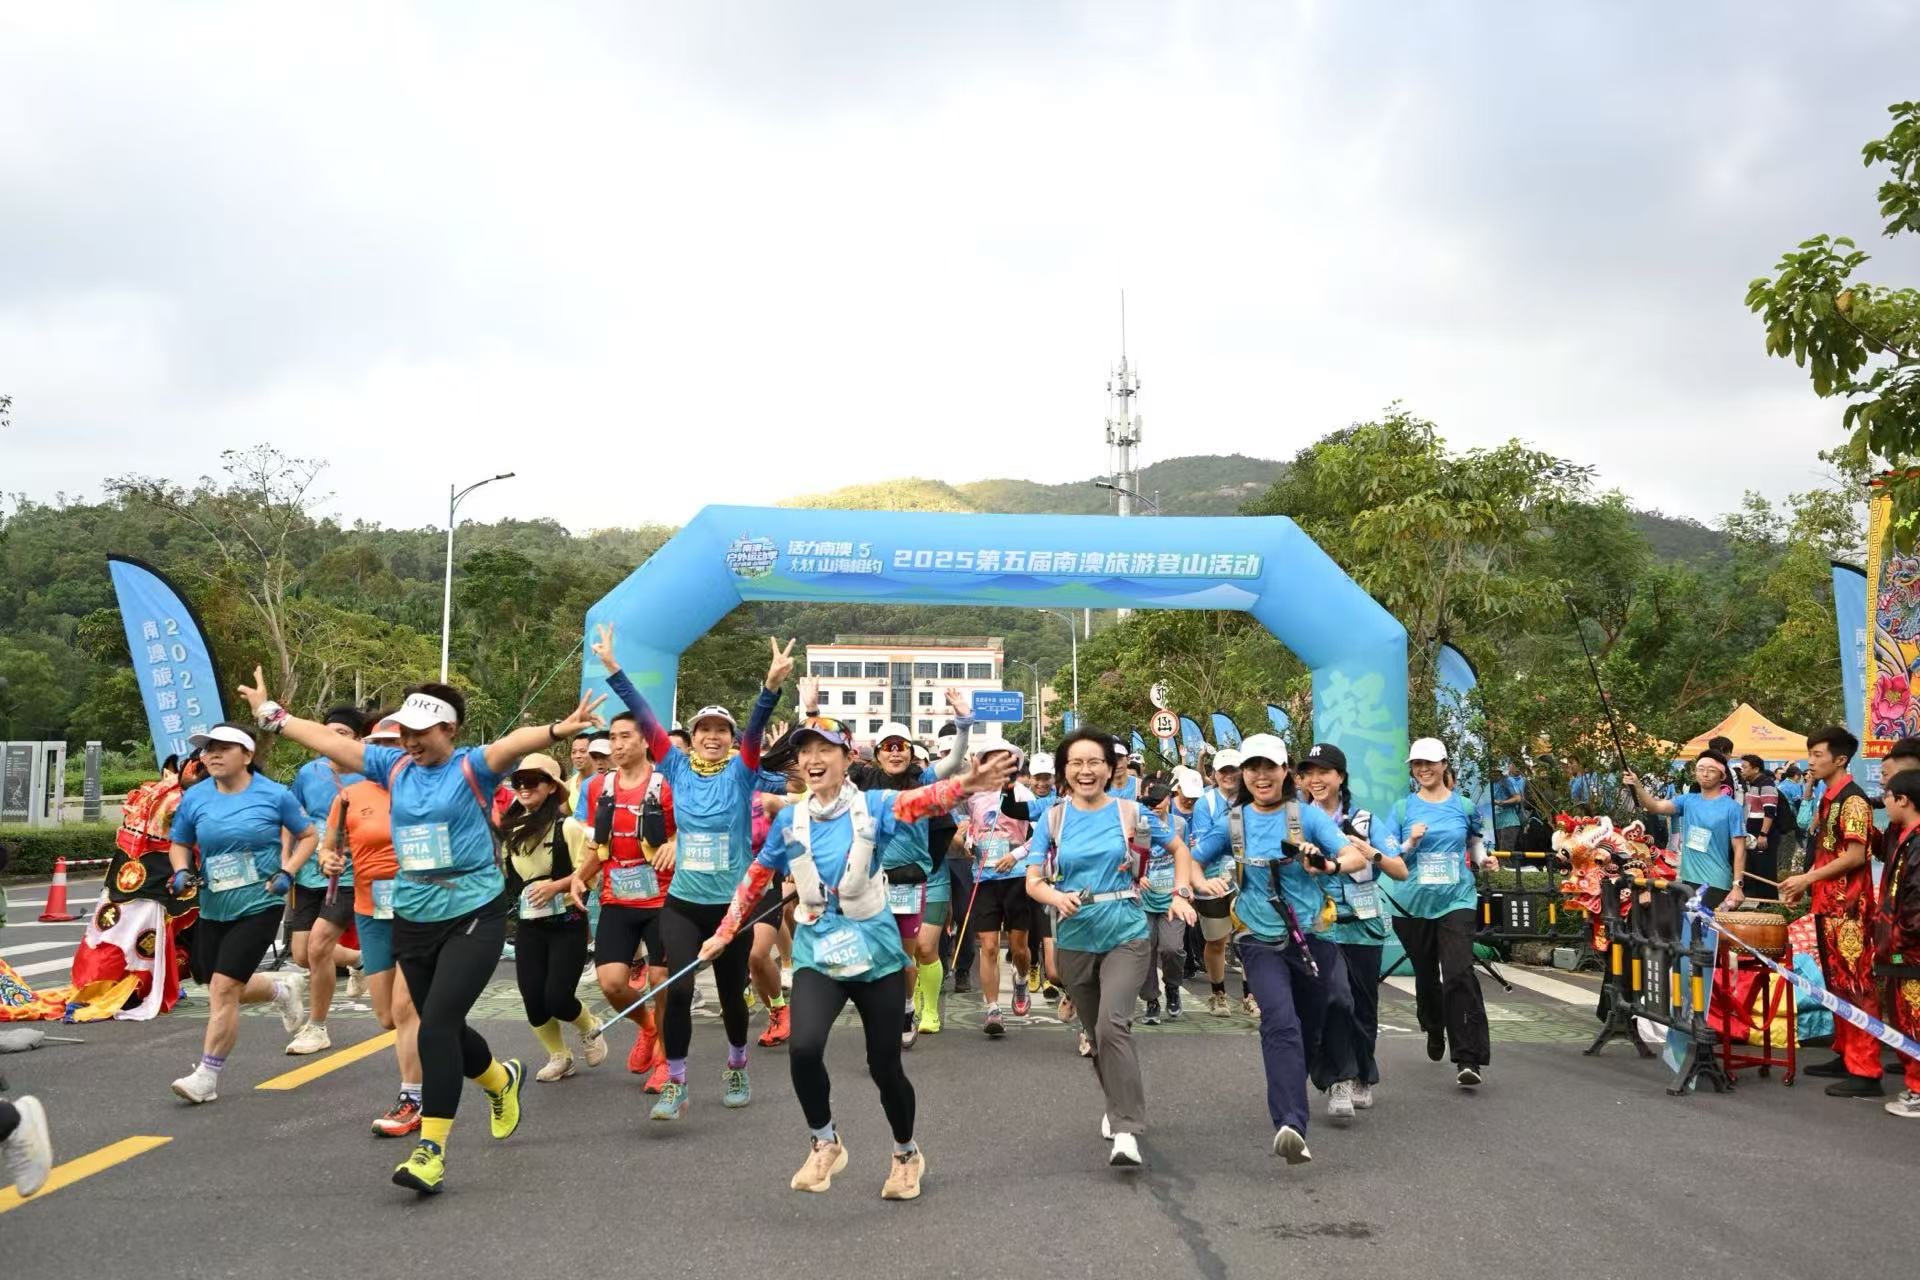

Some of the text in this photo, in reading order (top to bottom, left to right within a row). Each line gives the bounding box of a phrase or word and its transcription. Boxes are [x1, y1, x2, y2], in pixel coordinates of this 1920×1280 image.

[788, 540, 853, 556] 活力南澳
[818, 559, 883, 573] 山海相约
[893, 549, 1261, 576] 2025第五届南澳旅游登山活动
